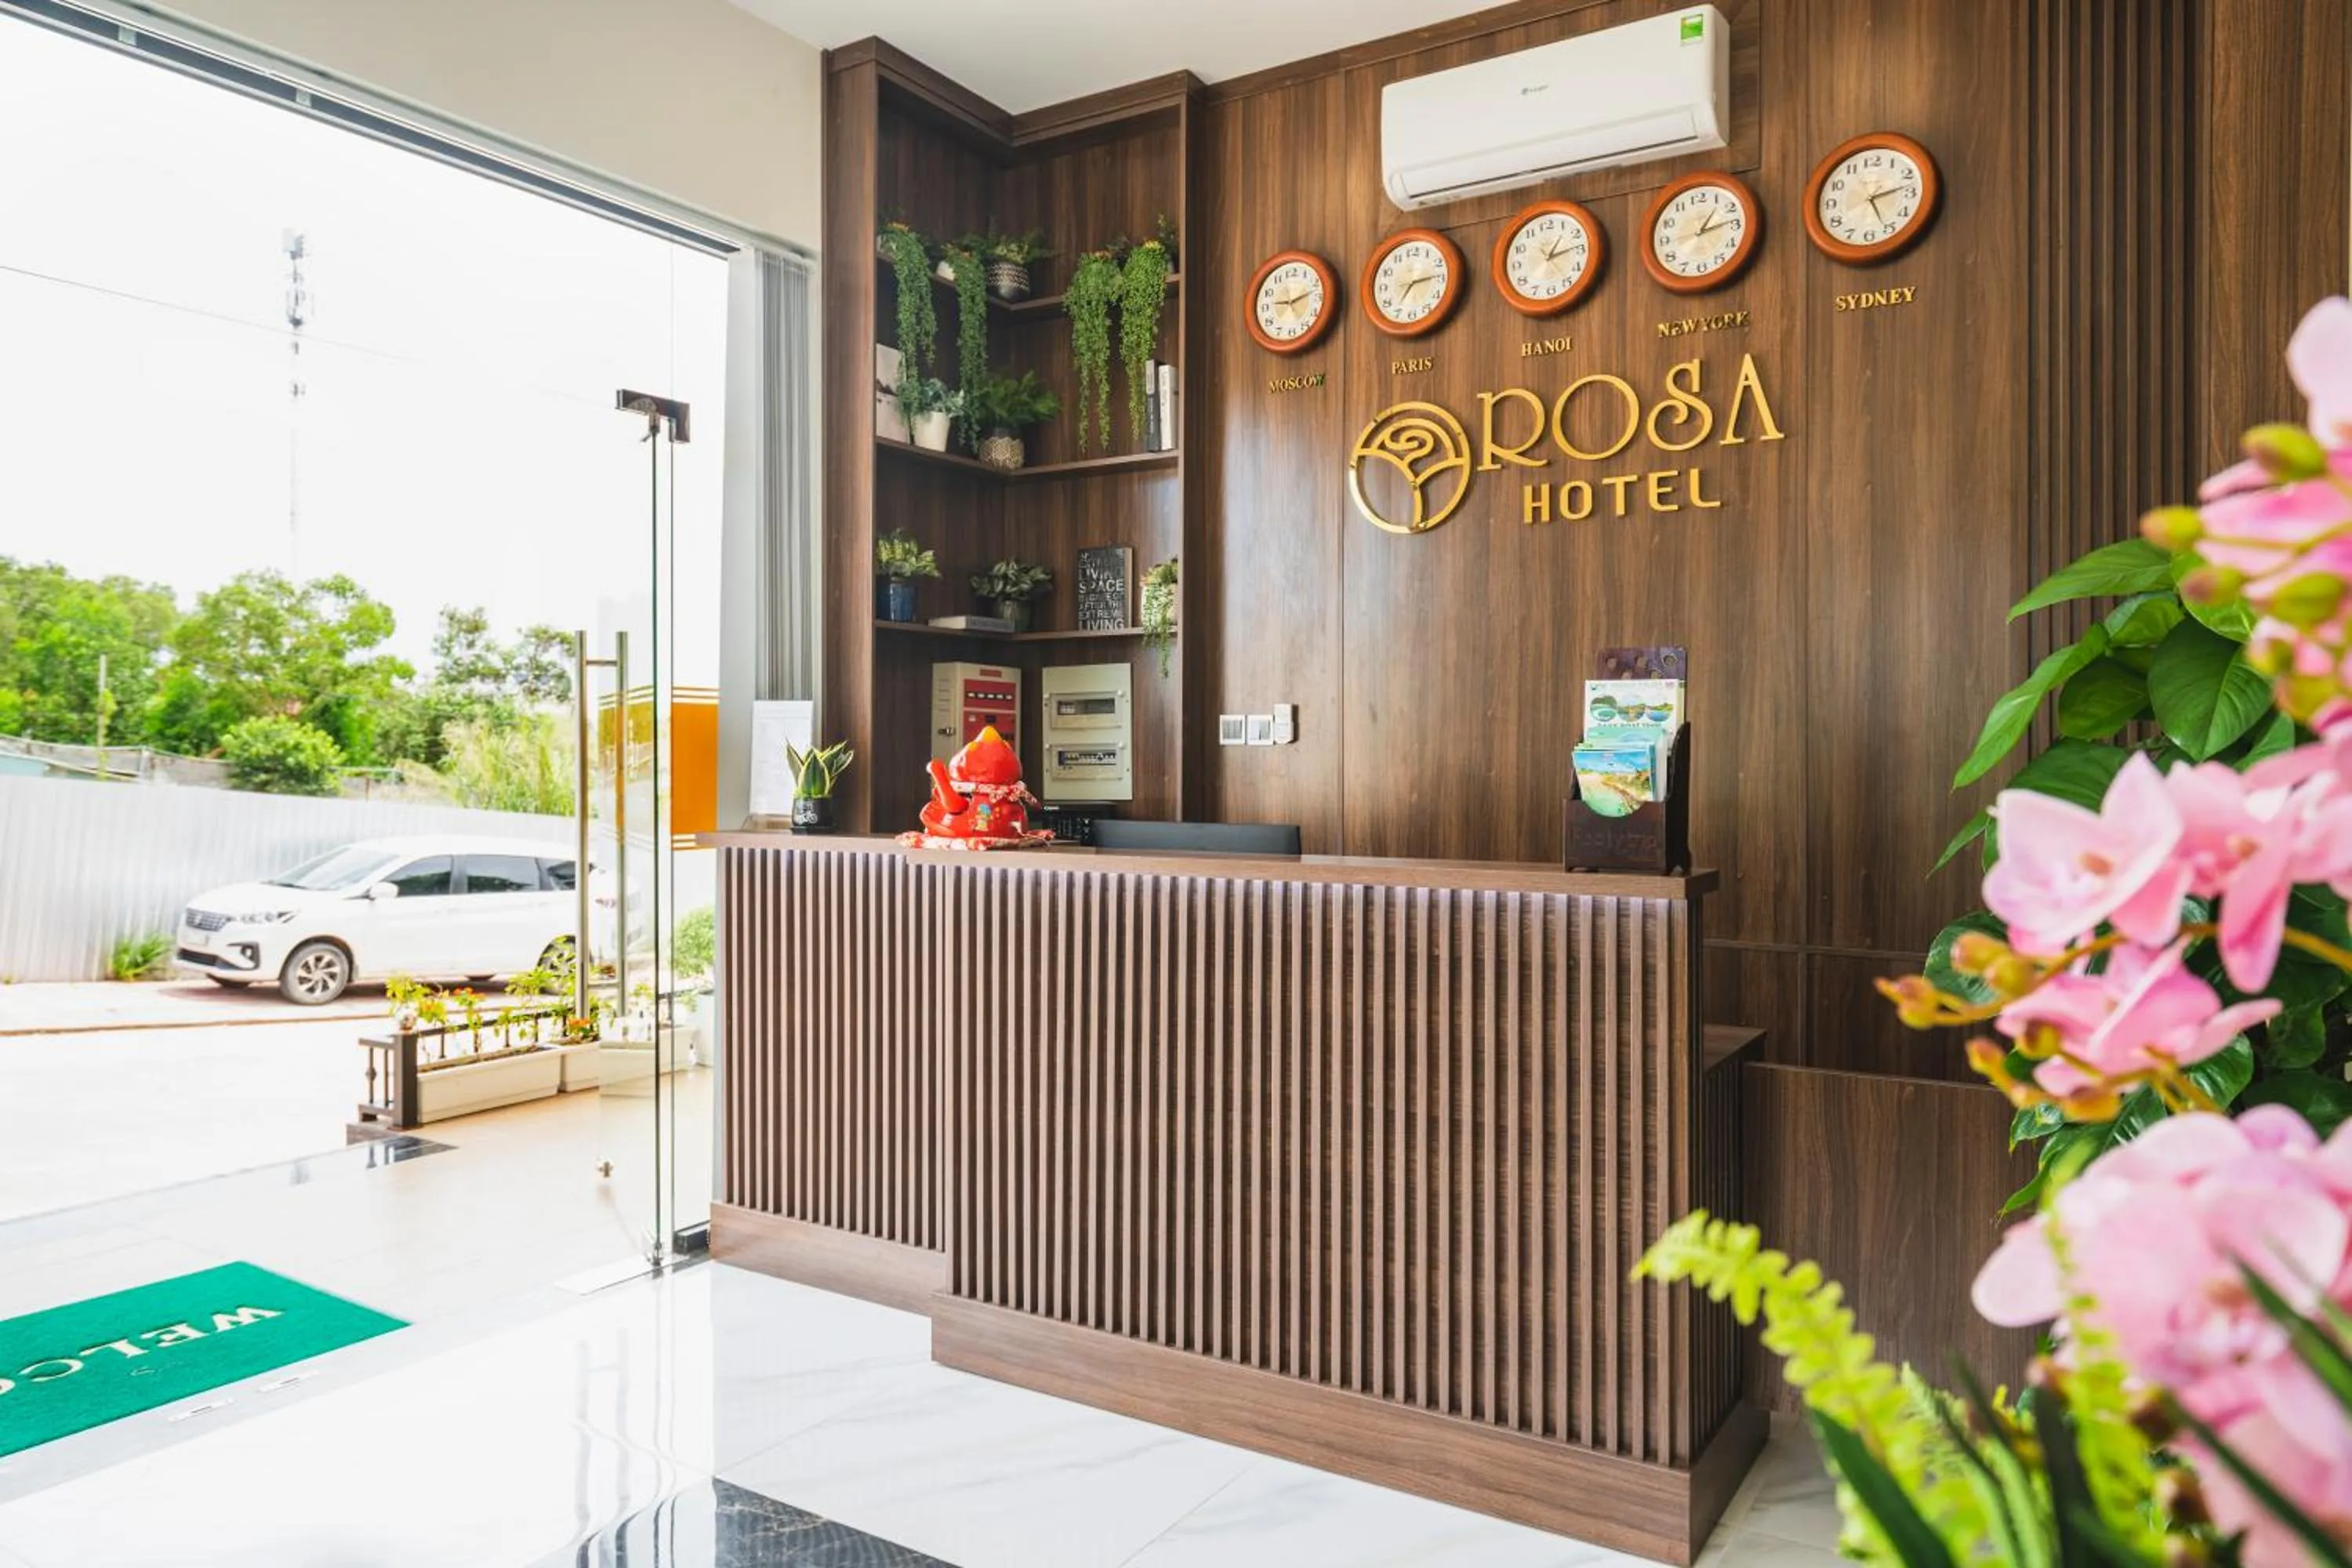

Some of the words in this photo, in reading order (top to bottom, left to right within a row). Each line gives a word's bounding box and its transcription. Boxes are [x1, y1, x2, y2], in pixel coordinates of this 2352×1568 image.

[1864, 155, 1882, 169] 12
[1846, 163, 1857, 175] 11
[1901, 167, 1914, 180] 2
[1832, 180, 1845, 191] 10
[1690, 192, 1707, 205] 12
[1904, 187, 1917, 198] 3
[1675, 201, 1686, 212] 11
[1725, 201, 1737, 212] 2
[1825, 198, 1837, 210] 9
[1897, 205, 1908, 217] 4
[1539, 220, 1554, 231] 12
[1663, 217, 1675, 230] 10
[1730, 219, 1741, 230] 3
[1830, 216, 1842, 228] 8
[1882, 221, 1896, 234] 5
[1526, 228, 1535, 239] 11
[1570, 228, 1581, 239] 2
[1844, 228, 1856, 239] 7
[1864, 230, 1875, 242] 6
[1660, 235, 1670, 247] 9
[1726, 236, 1736, 249] 4
[1515, 243, 1526, 254] 10
[1576, 244, 1586, 256] 3
[1664, 250, 1676, 263] 8
[1714, 252, 1726, 265] 5
[1512, 261, 1522, 271] 9
[1572, 262, 1581, 272] 4
[1679, 261, 1689, 274] 7
[1696, 263, 1708, 273] 6
[1517, 275, 1528, 286] 8
[1562, 276, 1572, 288] 5
[1530, 285, 1540, 296] 7
[1546, 285, 1556, 296] 6
[1835, 286, 1916, 312] SYDNEY
[1657, 319, 1697, 338] NEW
[1700, 310, 1749, 332] YORK
[1521, 336, 1573, 358] HANOI
[1392, 357, 1433, 376] PARIS
[1269, 373, 1325, 394] MOSCOW
[1476, 352, 1785, 471] ROSA
[1523, 467, 1722, 524] HOTEL
[1079, 579, 1124, 594] SPACE
[1078, 619, 1124, 631] LIVING
[0, 1305, 285, 1396] WELC
